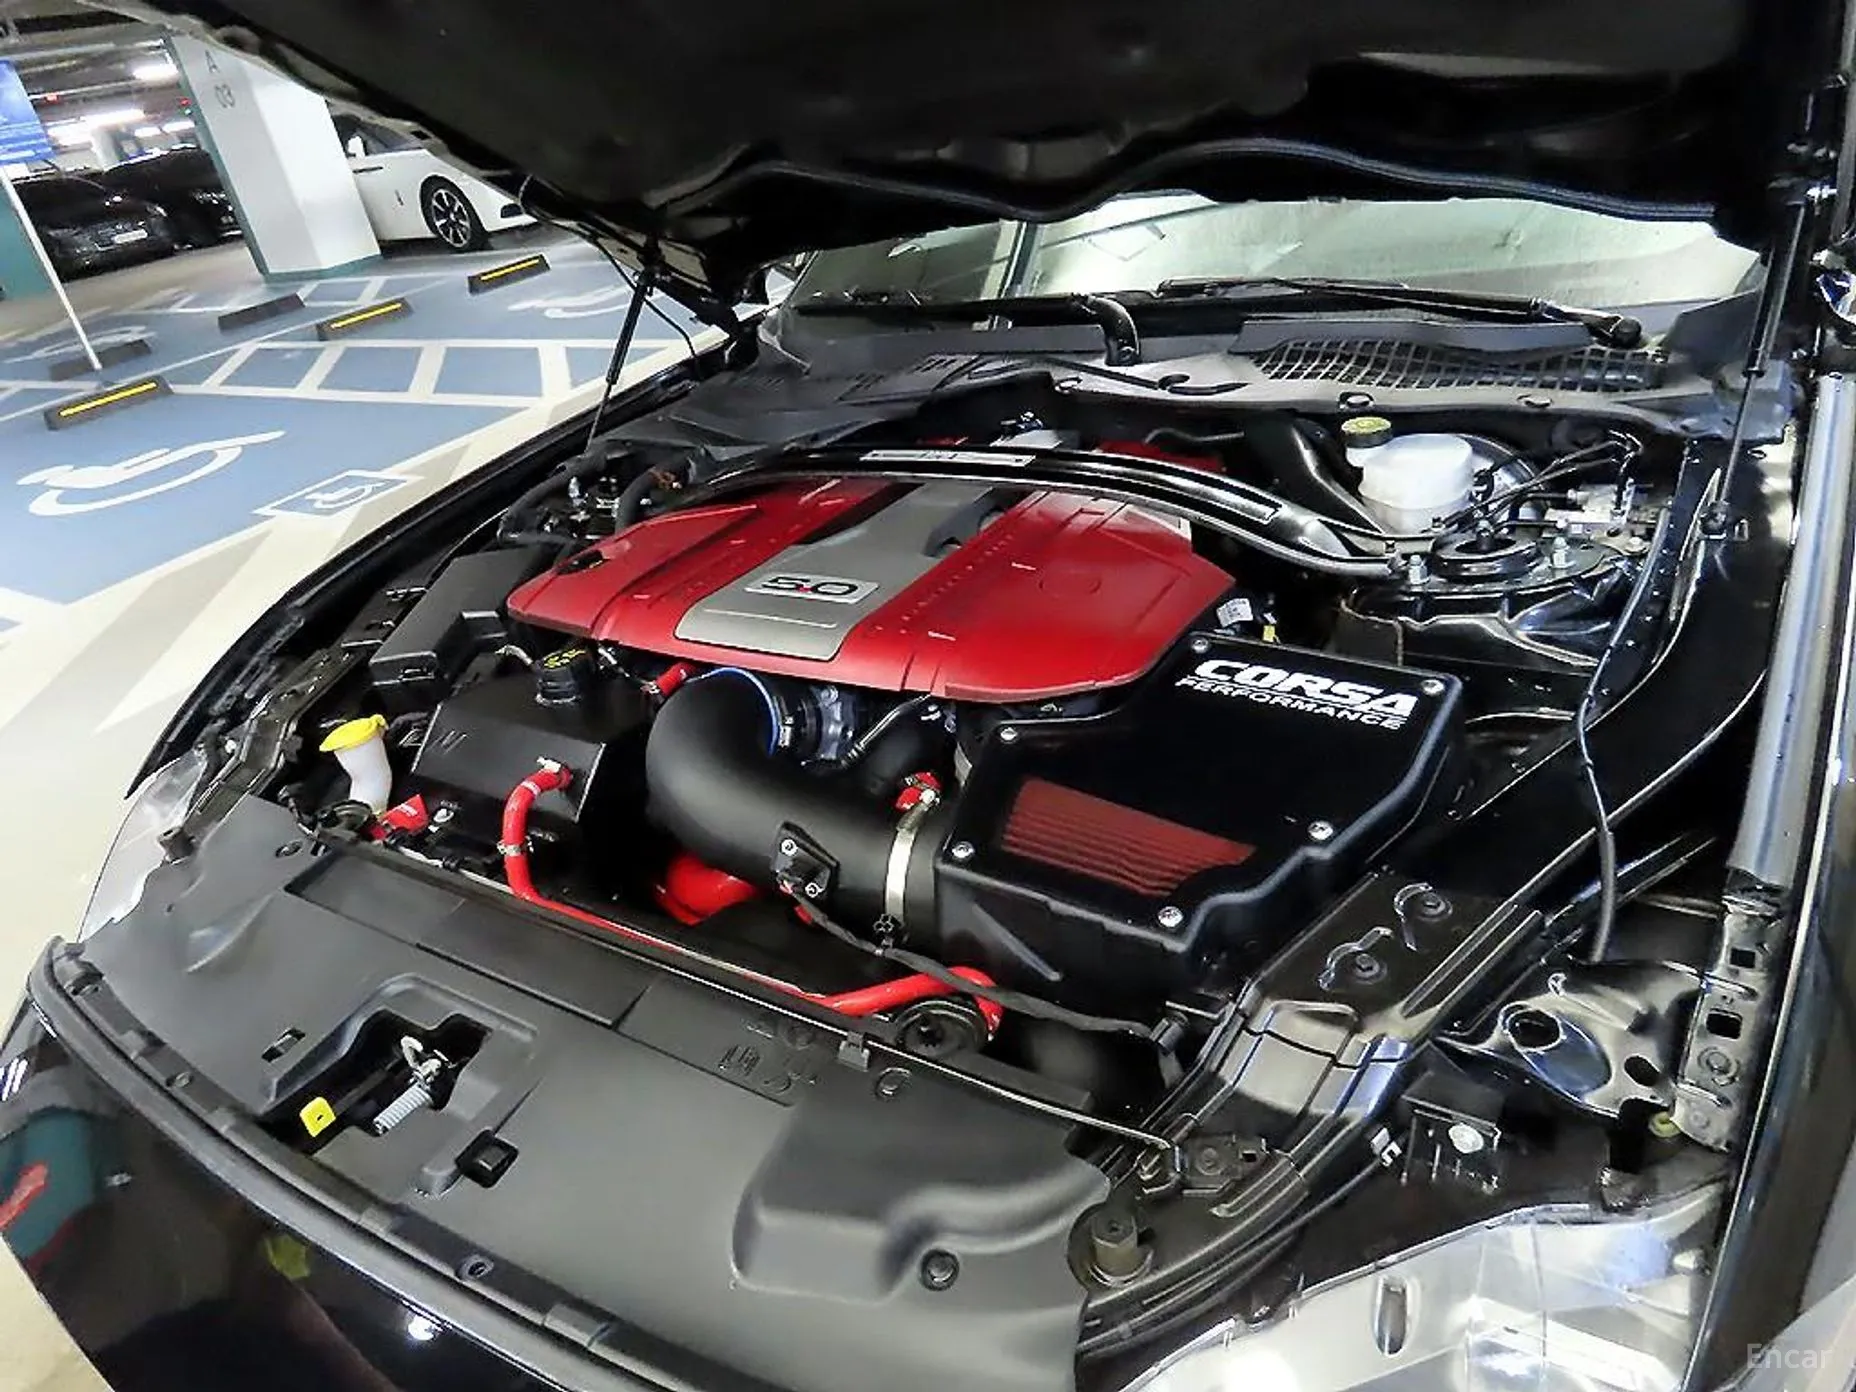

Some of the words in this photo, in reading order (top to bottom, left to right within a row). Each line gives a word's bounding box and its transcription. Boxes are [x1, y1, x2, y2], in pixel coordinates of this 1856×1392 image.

[204, 49, 220, 73] A
[761, 576, 859, 596] 5.0
[1174, 676, 1407, 731] PERFORMANCE
[1194, 659, 1420, 717] CORSA
